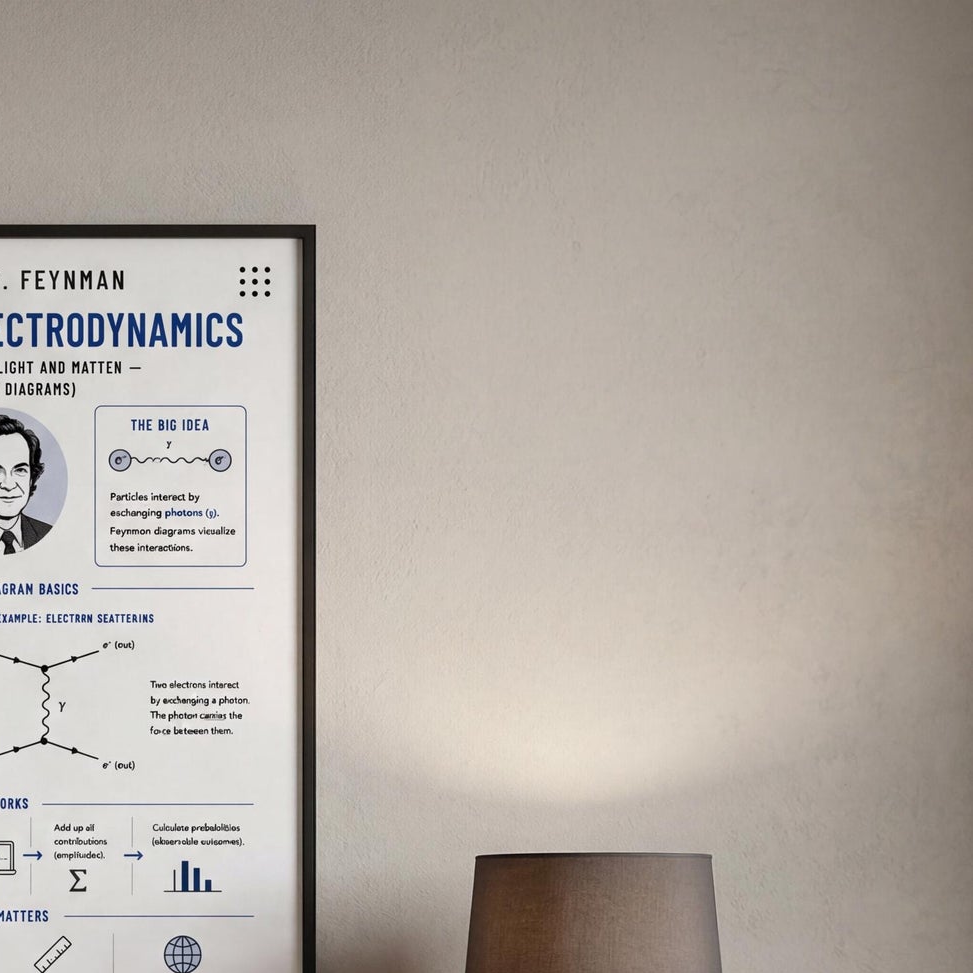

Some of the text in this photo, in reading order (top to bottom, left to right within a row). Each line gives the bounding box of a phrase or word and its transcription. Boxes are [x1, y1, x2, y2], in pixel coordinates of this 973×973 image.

[21, 270, 124, 290] FEYNMAN
[40, 361, 65, 374] AND
[72, 361, 121, 374] MATTEN
[5, 382, 75, 398] DIAGRAMS)
[131, 419, 209, 431] THE BIG IDEA
[110, 492, 148, 501] Particles
[188, 492, 200, 503] by
[165, 507, 203, 519] photons
[154, 526, 195, 537] diagrams
[110, 543, 135, 552] these
[39, 583, 78, 595] BASICS
[151, 696, 160, 706] by
[150, 711, 166, 719] The
[229, 711, 242, 719] the
